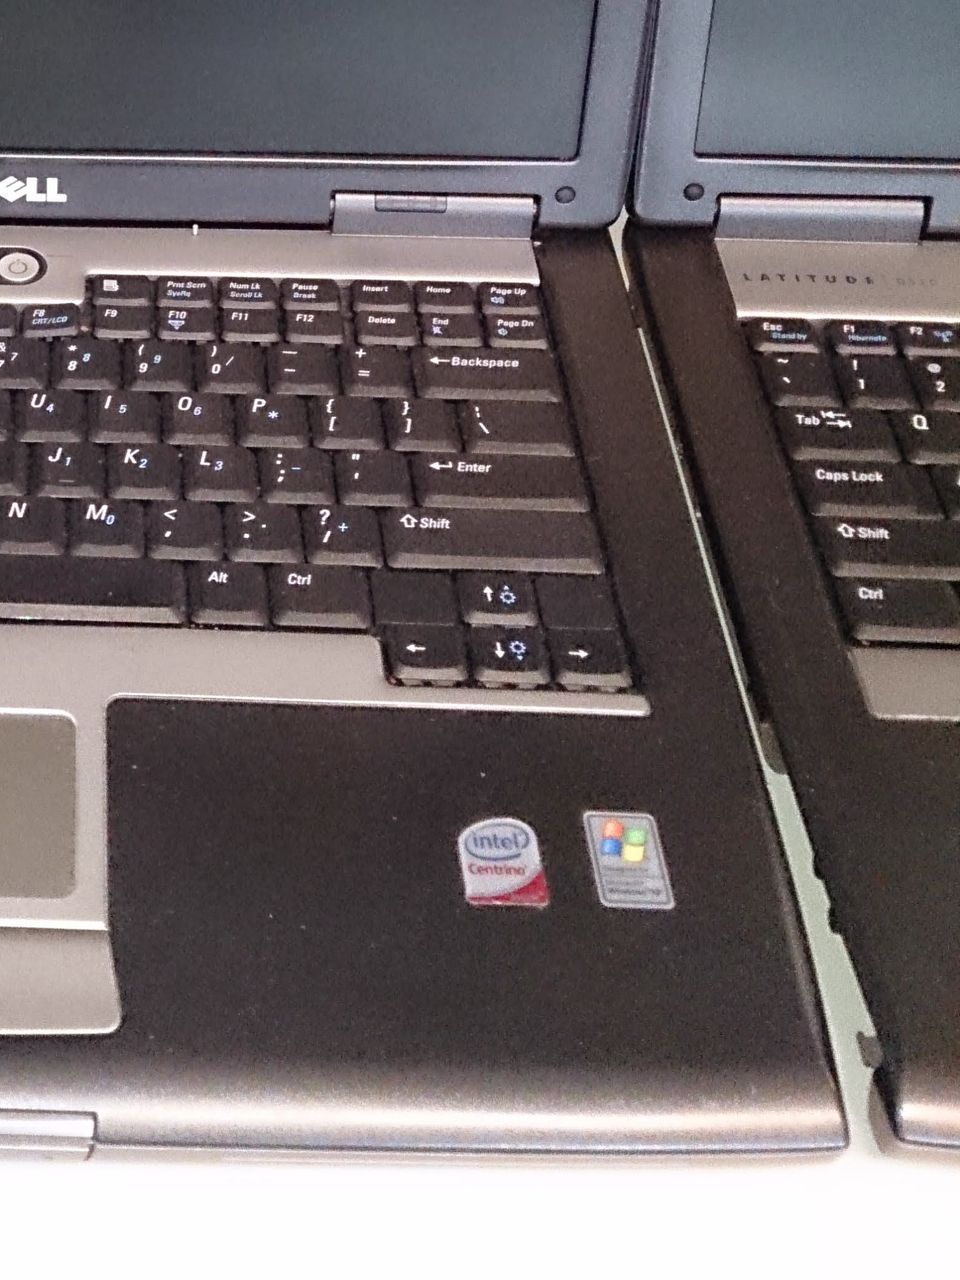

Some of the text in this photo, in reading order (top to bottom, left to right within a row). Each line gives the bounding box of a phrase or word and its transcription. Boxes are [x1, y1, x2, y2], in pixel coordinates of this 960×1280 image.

[744, 273, 874, 284] LATITUDE
[33, 309, 45, 317] F8
[105, 309, 117, 317] F9
[168, 311, 186, 319] F10
[232, 312, 248, 320] F11
[296, 314, 314, 322] F12
[843, 325, 855, 333] F1
[910, 326, 923, 335] F2
[11, 352, 18, 360] 7
[83, 353, 90, 362] 8
[154, 355, 161, 363] 9
[68, 361, 77, 371] 8
[451, 356, 519, 368] Backspace
[139, 363, 148, 373] 9
[212, 364, 221, 374] 0
[859, 379, 864, 389] 1
[936, 381, 945, 392] 2
[31, 394, 46, 408] U
[105, 396, 112, 409] I
[178, 397, 192, 410] O
[252, 399, 266, 412] P
[46, 404, 54, 412] 4
[119, 405, 127, 413] 5
[194, 407, 202, 415] 6
[795, 414, 820, 425] Tab
[912, 415, 929, 430] Q
[48, 448, 62, 462] J
[124, 449, 139, 464] K
[200, 451, 210, 465] L
[66, 457, 71, 466] 1
[139, 459, 147, 468] 2
[215, 461, 223, 470] 3
[457, 462, 491, 473] Enter
[815, 469, 883, 482] Caps Lock
[8, 502, 27, 518] N
[86, 504, 107, 520] M
[320, 509, 330, 525] ?
[420, 516, 450, 530] Shift
[858, 528, 890, 540] Shift
[208, 571, 228, 584] Alt
[288, 572, 311, 586] Ctrl
[858, 587, 884, 600] Ctrl
[471, 831, 520, 850] intel
[468, 863, 525, 876] Centrino
